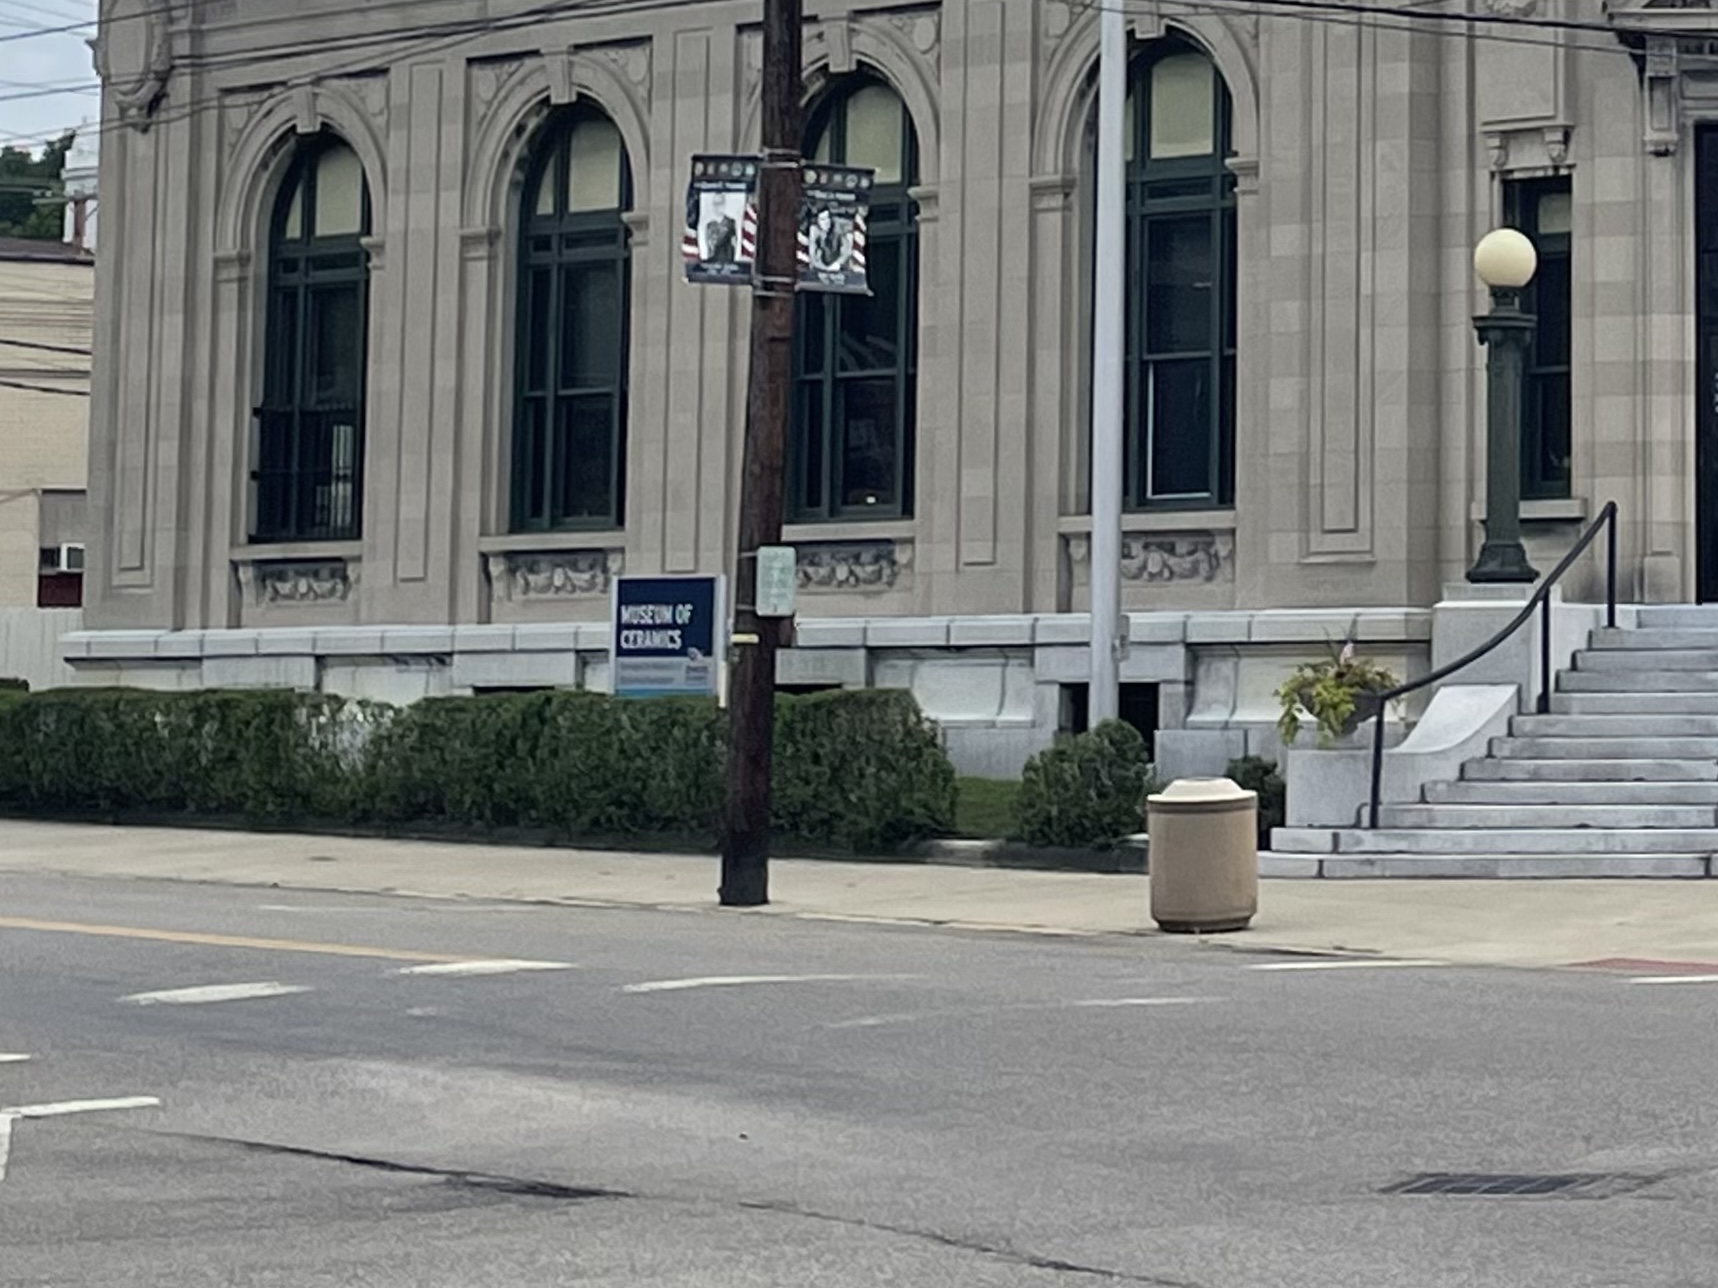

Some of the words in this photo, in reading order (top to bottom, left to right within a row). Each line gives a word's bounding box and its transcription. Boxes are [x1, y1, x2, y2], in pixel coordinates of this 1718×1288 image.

[620, 604, 674, 625] MUSEUM
[675, 603, 693, 625] OF
[620, 629, 683, 650] CERAMICS
